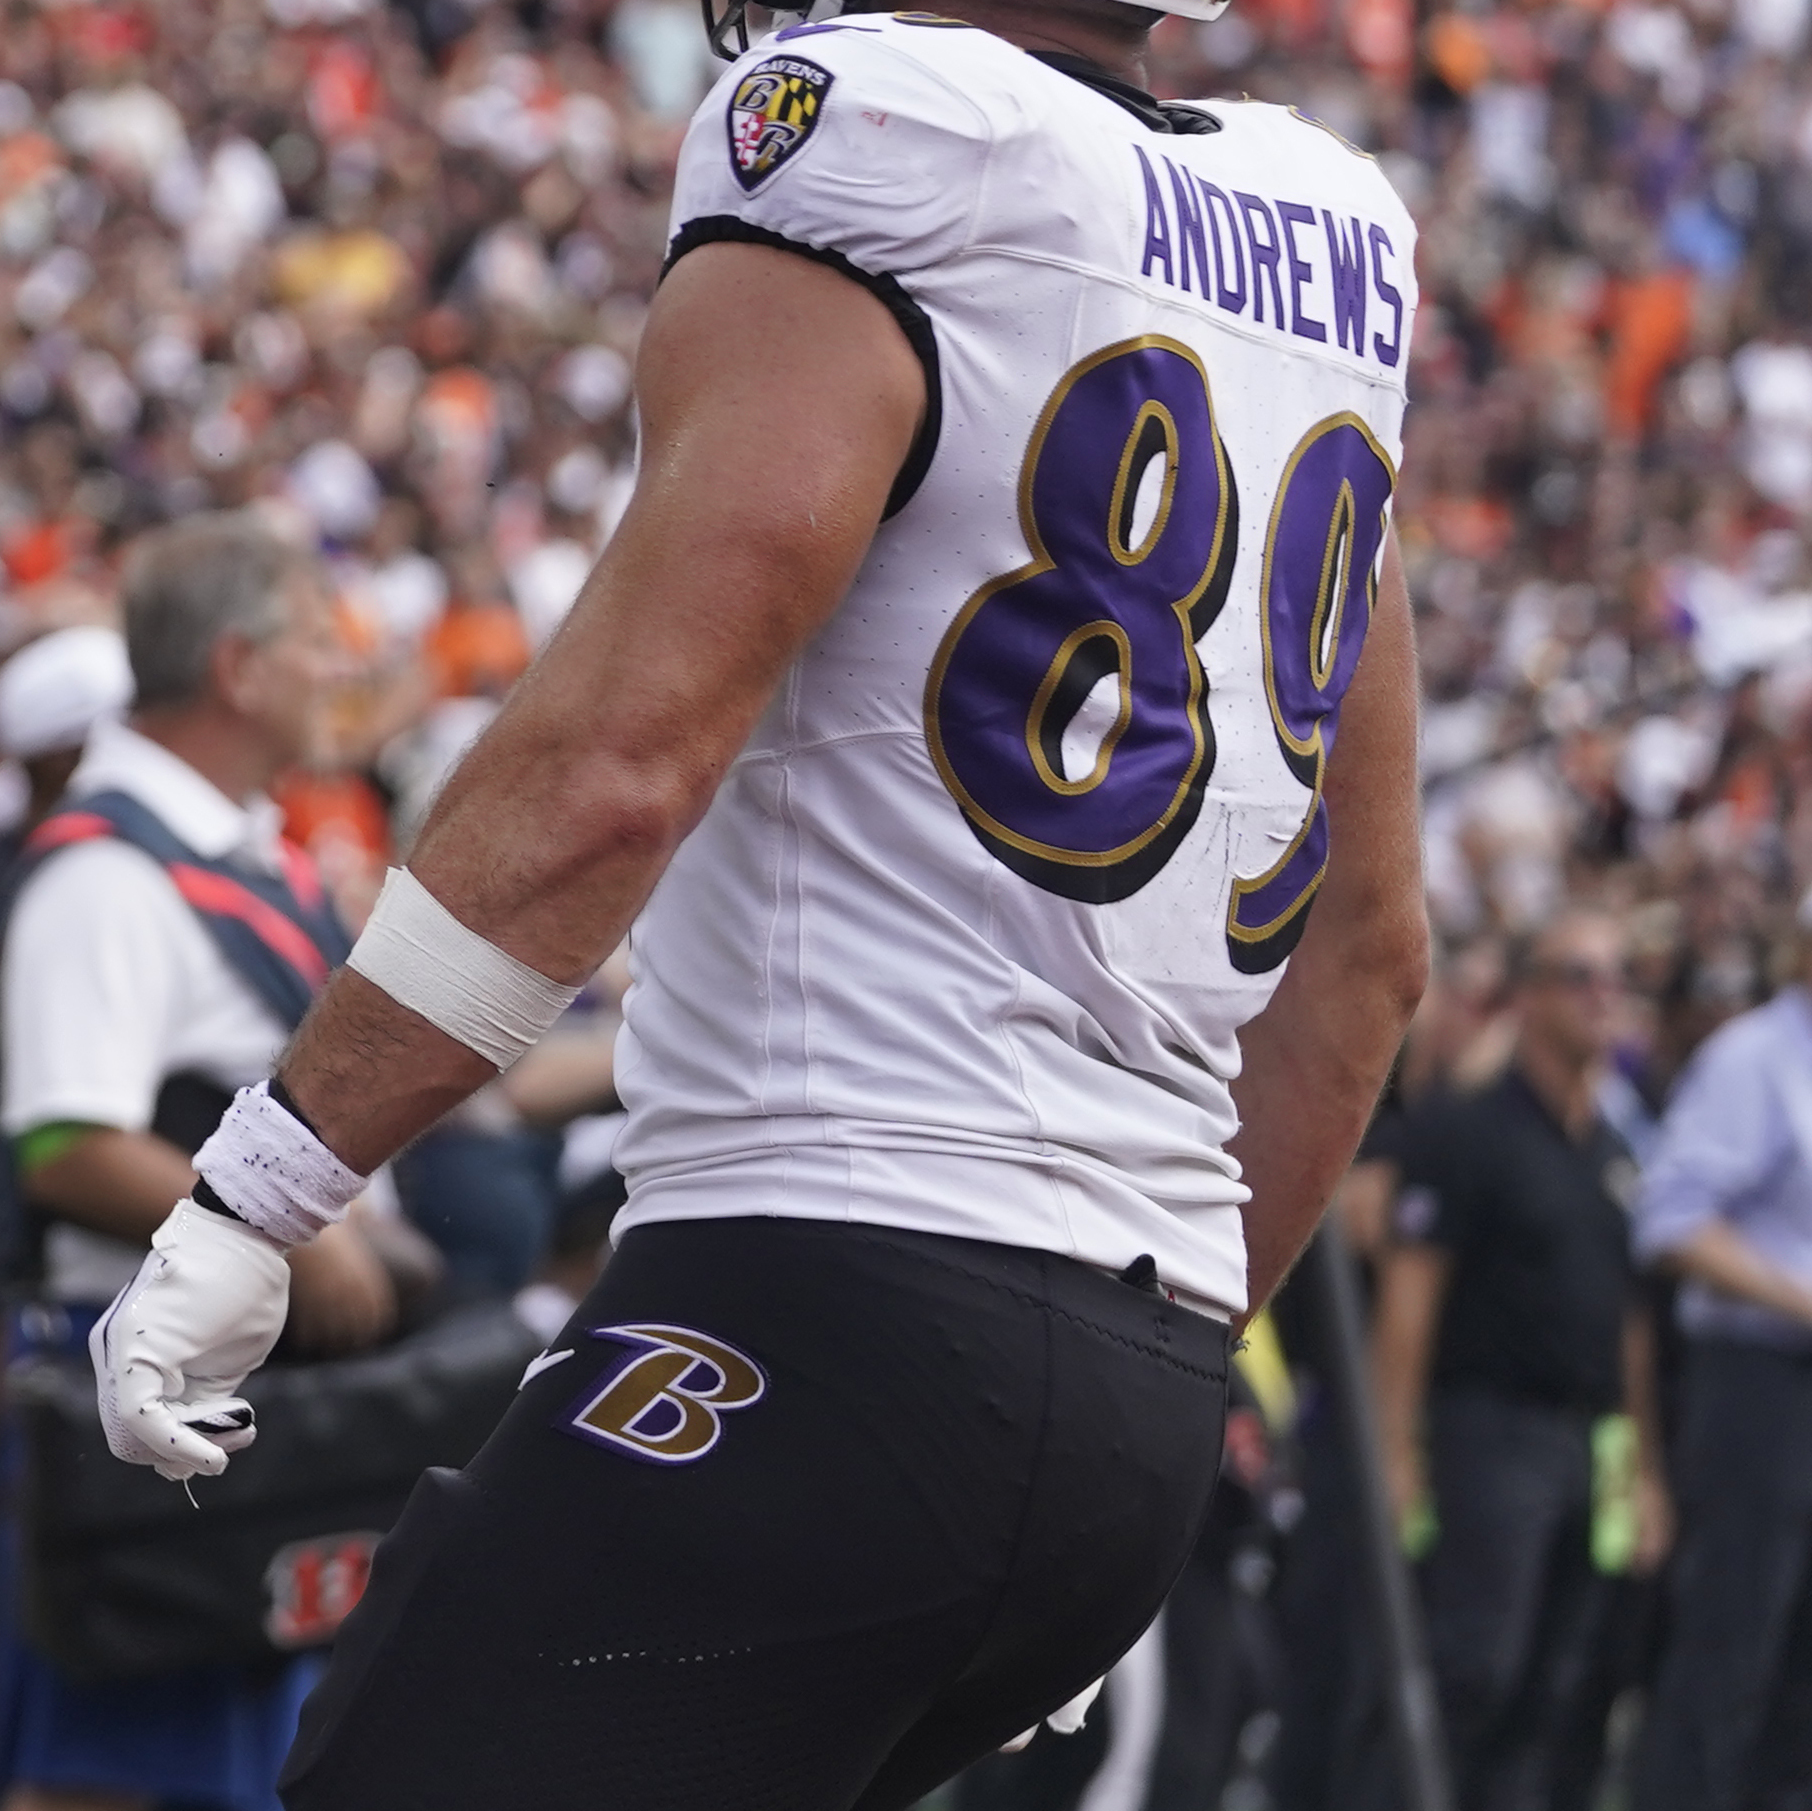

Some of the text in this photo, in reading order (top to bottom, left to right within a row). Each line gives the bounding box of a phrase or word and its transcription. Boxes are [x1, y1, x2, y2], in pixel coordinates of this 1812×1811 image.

[1131, 143, 1403, 370] ANDREWS
[923, 332, 1399, 976] 89
[557, 1320, 771, 1468] B
